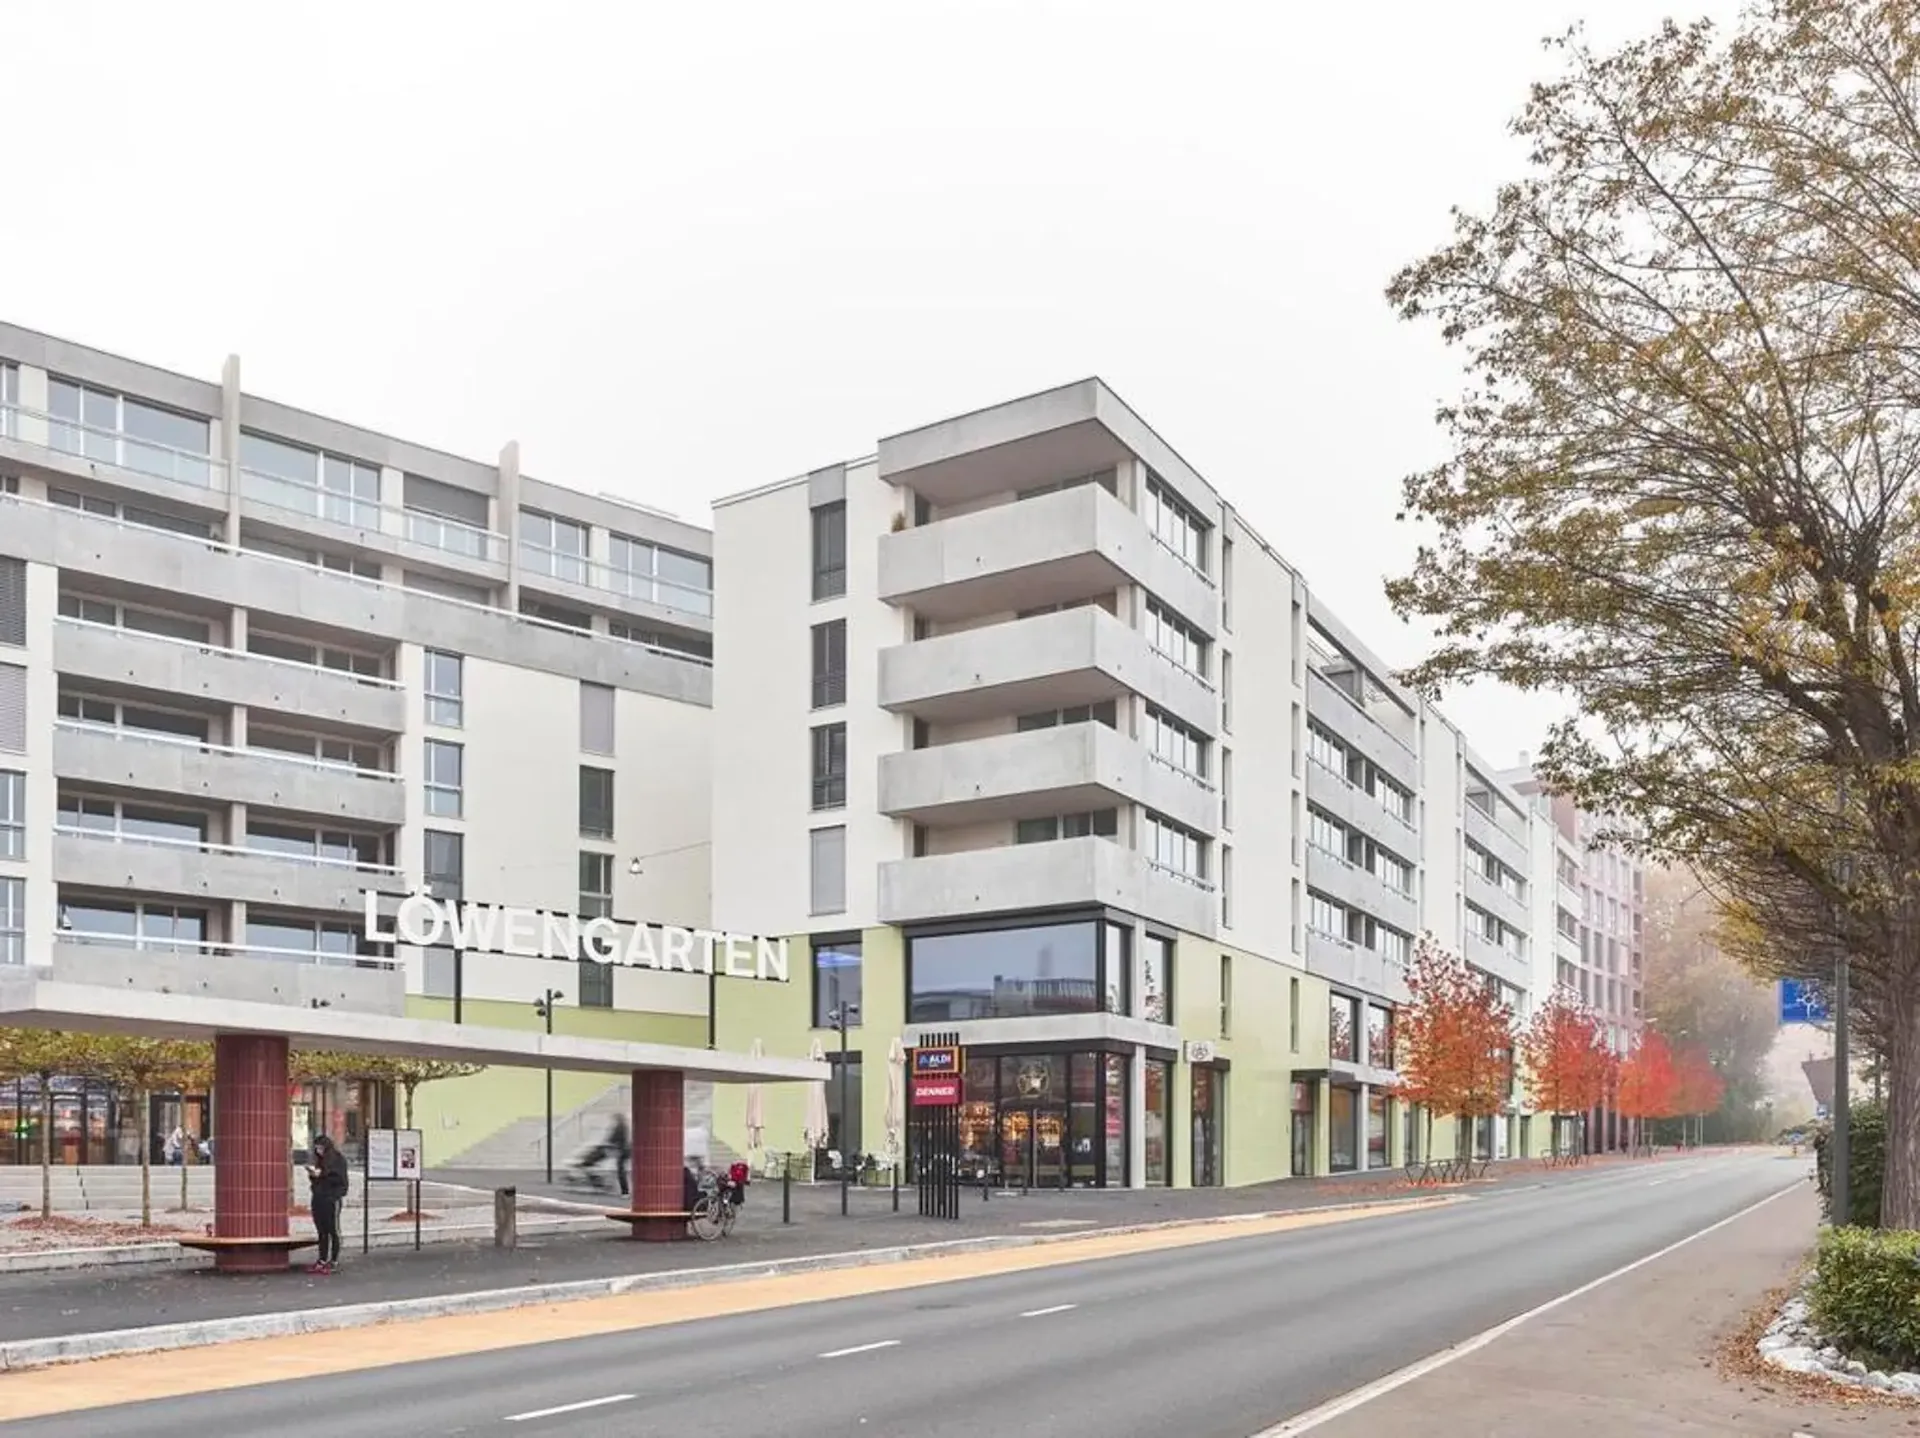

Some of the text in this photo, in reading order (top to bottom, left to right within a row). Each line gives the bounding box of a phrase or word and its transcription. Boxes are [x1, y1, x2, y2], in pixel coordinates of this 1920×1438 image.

[365, 883, 788, 981] LÖWENGARTEN
[929, 1054, 951, 1064] ALDI
[915, 1086, 955, 1097] DENNER
